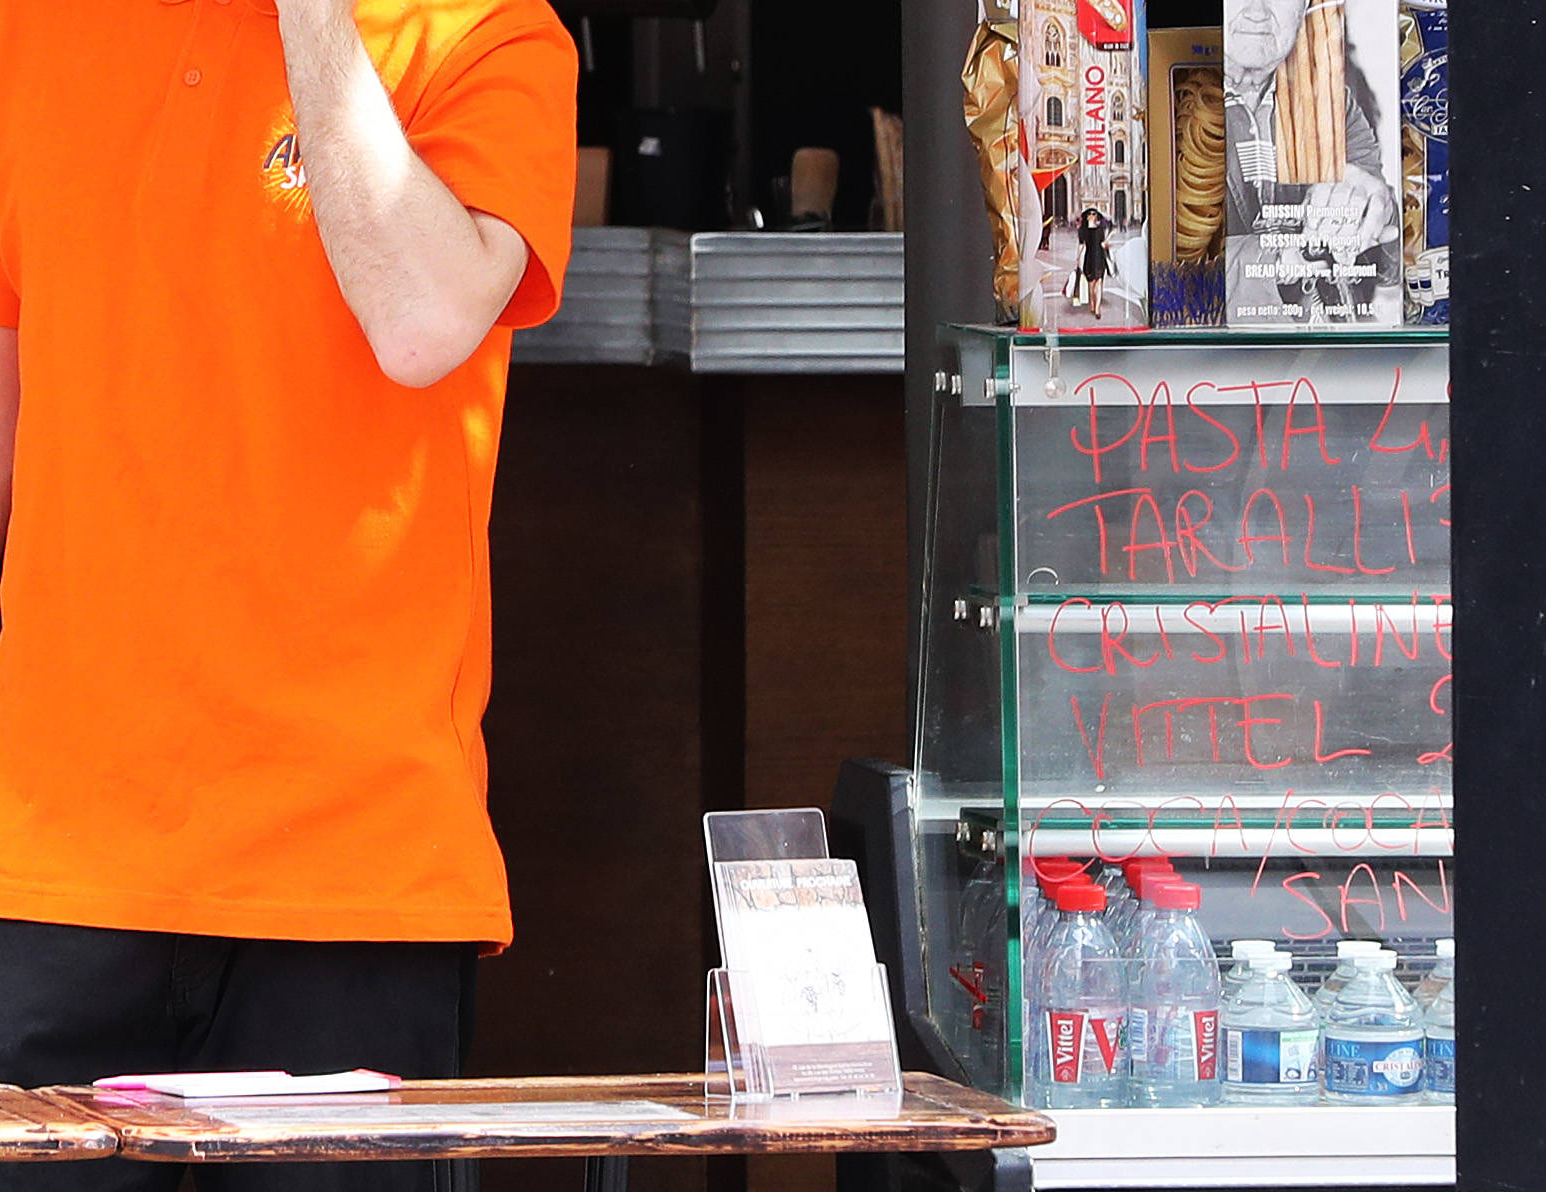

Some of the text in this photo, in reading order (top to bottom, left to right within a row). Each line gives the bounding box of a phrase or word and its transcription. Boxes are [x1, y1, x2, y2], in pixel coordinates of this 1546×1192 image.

[1085, 65, 1106, 166] MILANO
[1245, 264, 1276, 278] BREAD
[1071, 373, 1342, 483] PASTA
[1046, 485, 1417, 583] TARALLI
[1071, 694, 1372, 779] VITTEL
[1057, 1019, 1074, 1066] Vittel
[1201, 1015, 1215, 1063] Vittel
